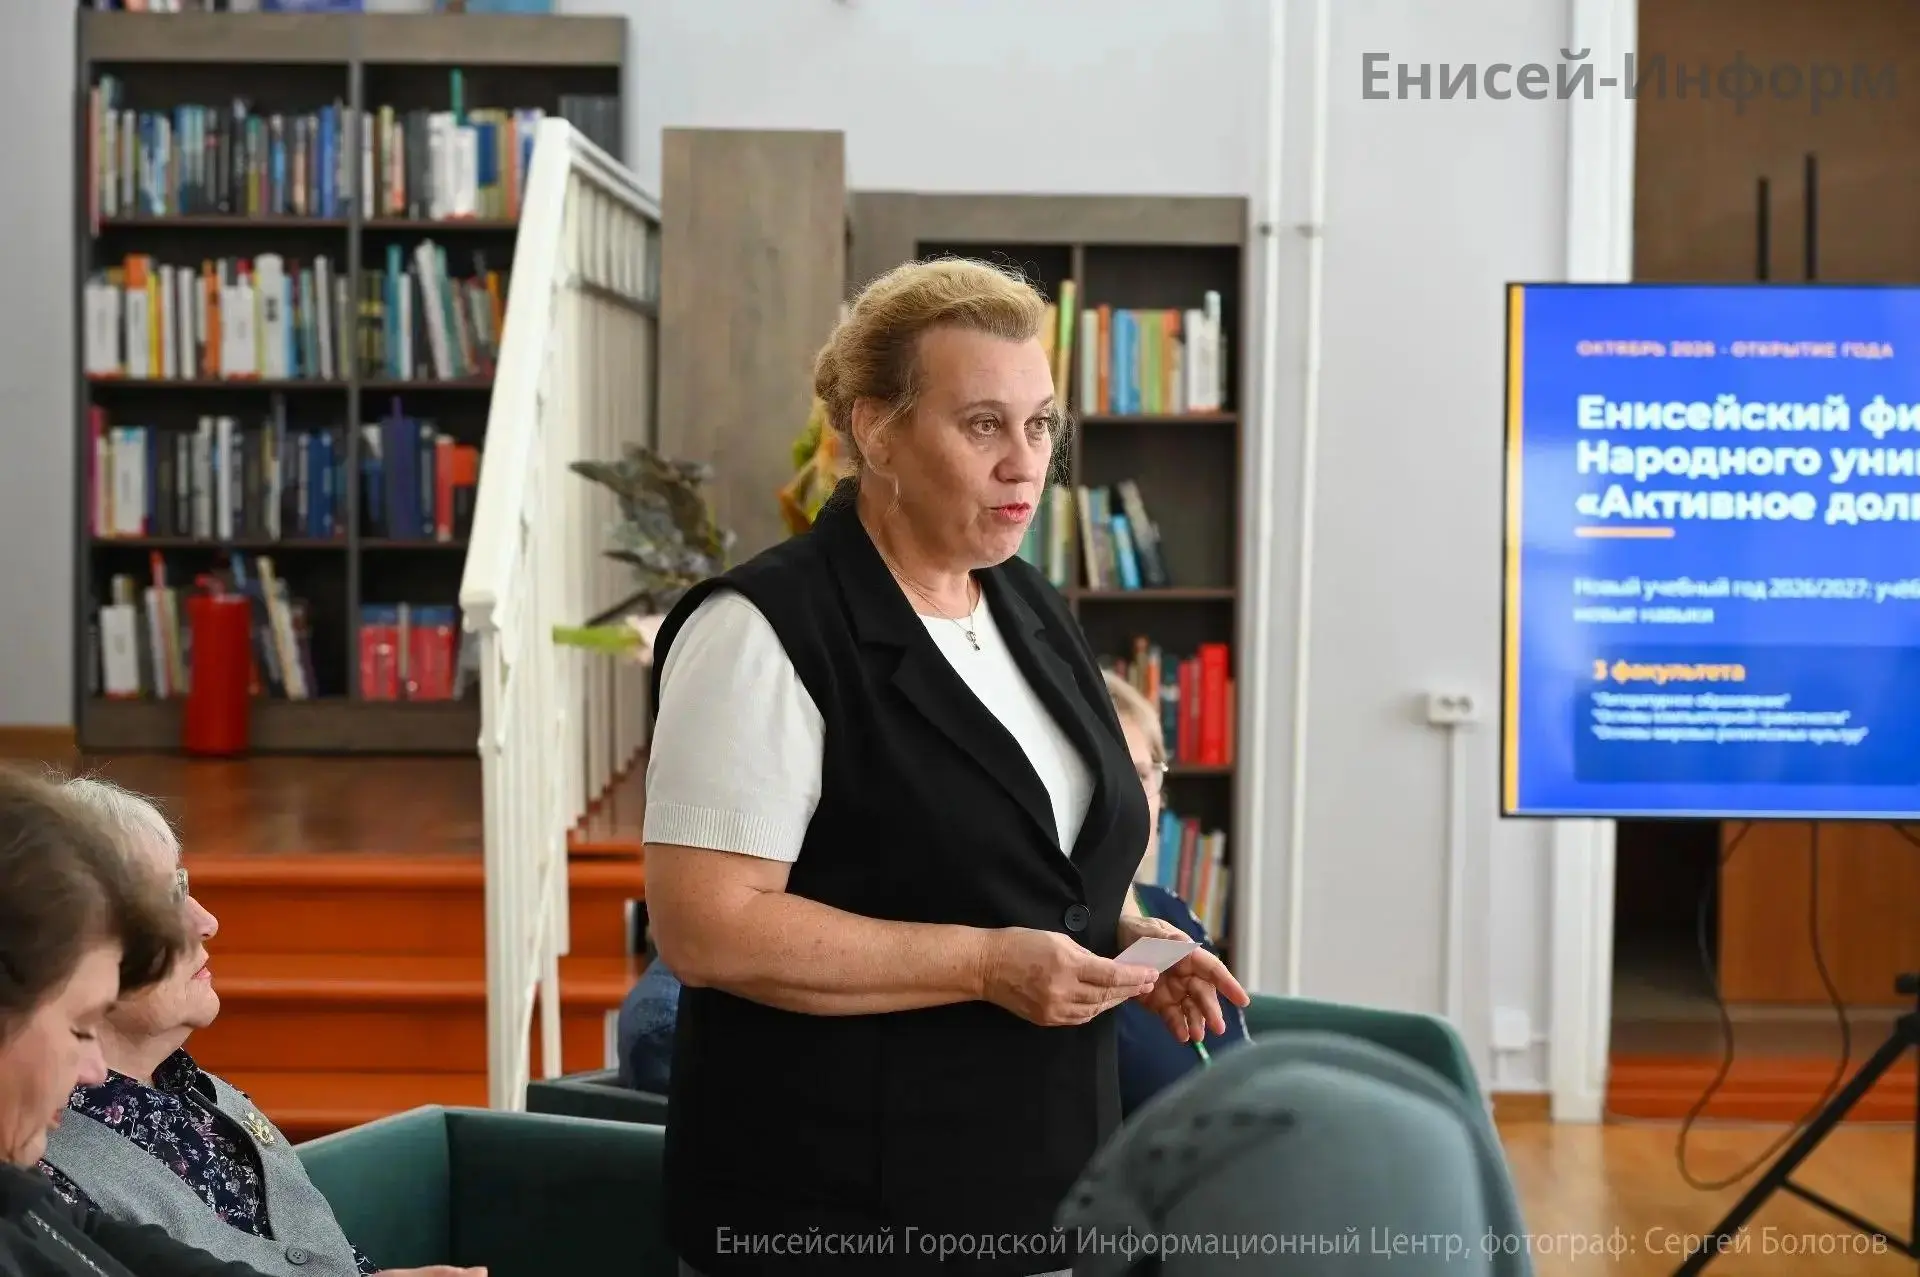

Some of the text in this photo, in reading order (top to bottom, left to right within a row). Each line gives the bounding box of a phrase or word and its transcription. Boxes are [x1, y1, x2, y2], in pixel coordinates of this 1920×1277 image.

[1577, 394, 1850, 431] Енисейский
[1576, 439, 1920, 484] Народного уни
[1575, 484, 1817, 520] «Активное
[1732, 579, 1767, 601] год
[1611, 659, 1746, 685] факультета
